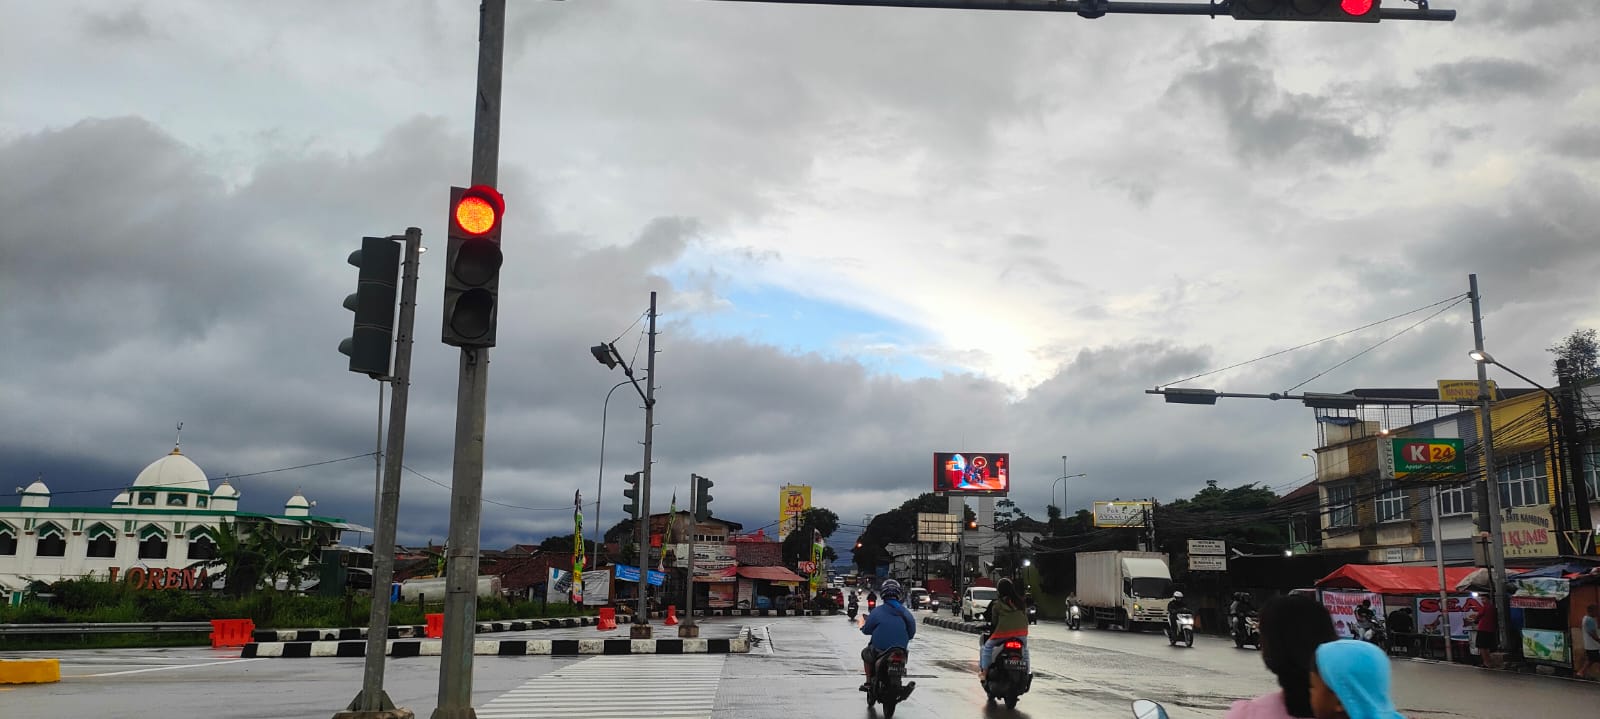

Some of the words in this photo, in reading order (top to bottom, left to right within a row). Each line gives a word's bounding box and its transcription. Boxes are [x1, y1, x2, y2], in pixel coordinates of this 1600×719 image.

[1385, 440, 1394, 477] APOTEK
[1410, 445, 1426, 461] K
[1432, 447, 1454, 461] 24
[1520, 513, 1549, 528] KAMBING
[1509, 528, 1548, 548] KUMIS
